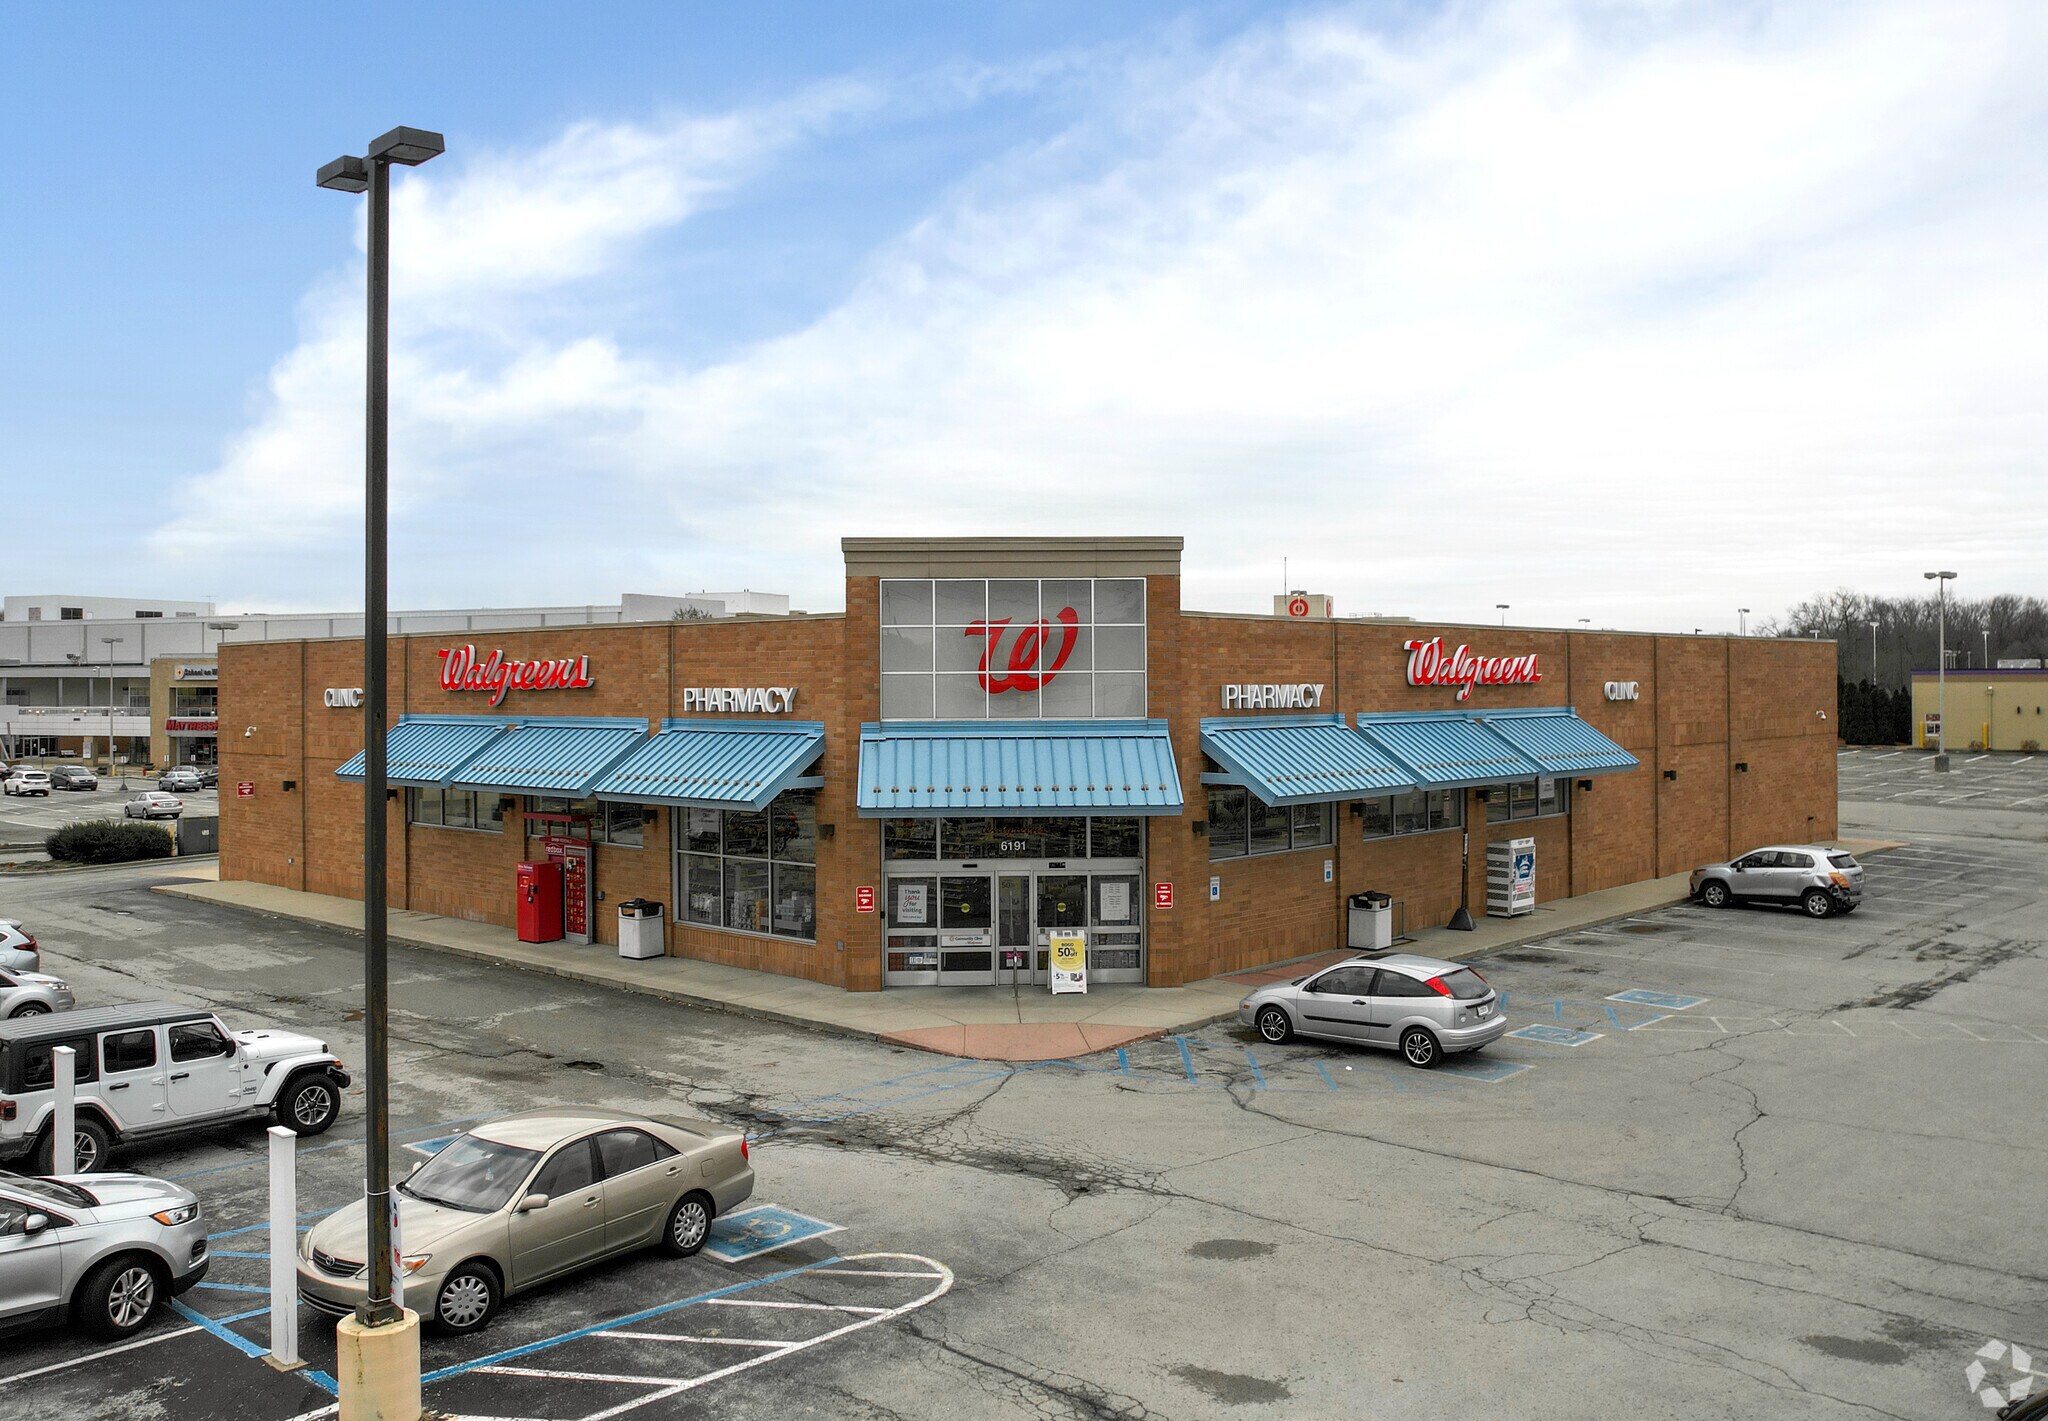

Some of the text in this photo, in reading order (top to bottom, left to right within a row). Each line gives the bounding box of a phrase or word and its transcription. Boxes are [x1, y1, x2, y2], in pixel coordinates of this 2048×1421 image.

[437, 644, 595, 707] Walgreens
[1404, 637, 1543, 700] Walgreens
[324, 688, 364, 707] CLINIC
[684, 687, 799, 713] PHARMACY
[1221, 683, 1324, 709] PHARMACY
[1604, 681, 1639, 700] CLINIC
[545, 846, 563, 854] redbox
[1000, 841, 1026, 851] 6191
[903, 895, 921, 907] you
